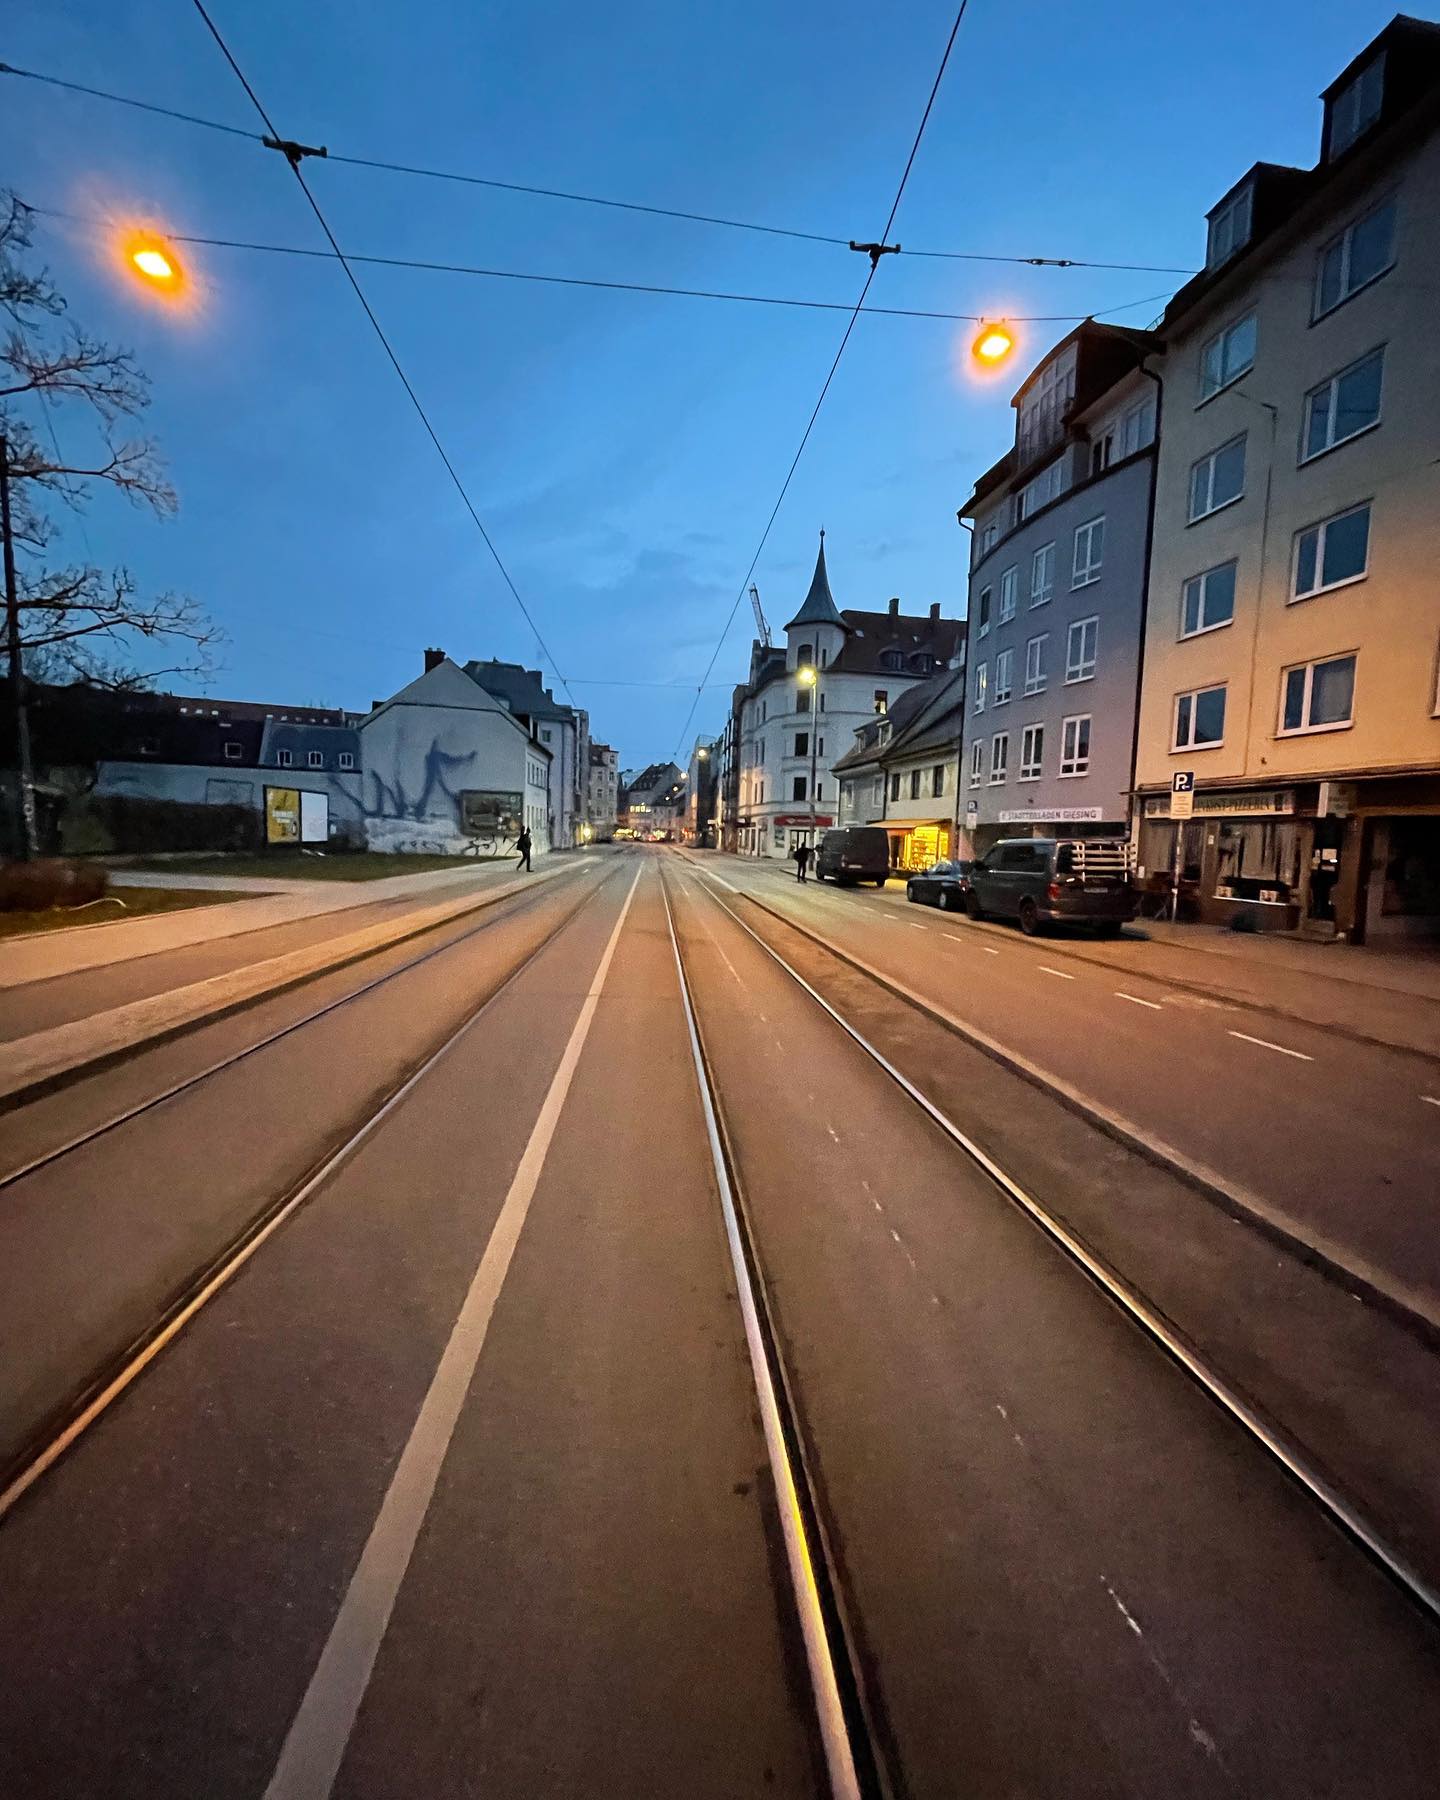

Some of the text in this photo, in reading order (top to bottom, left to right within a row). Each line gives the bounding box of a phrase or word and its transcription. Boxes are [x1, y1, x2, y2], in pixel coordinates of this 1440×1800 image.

[1175, 774, 1187, 790] P
[968, 801, 976, 811] P
[1063, 809, 1097, 819] GIESING
